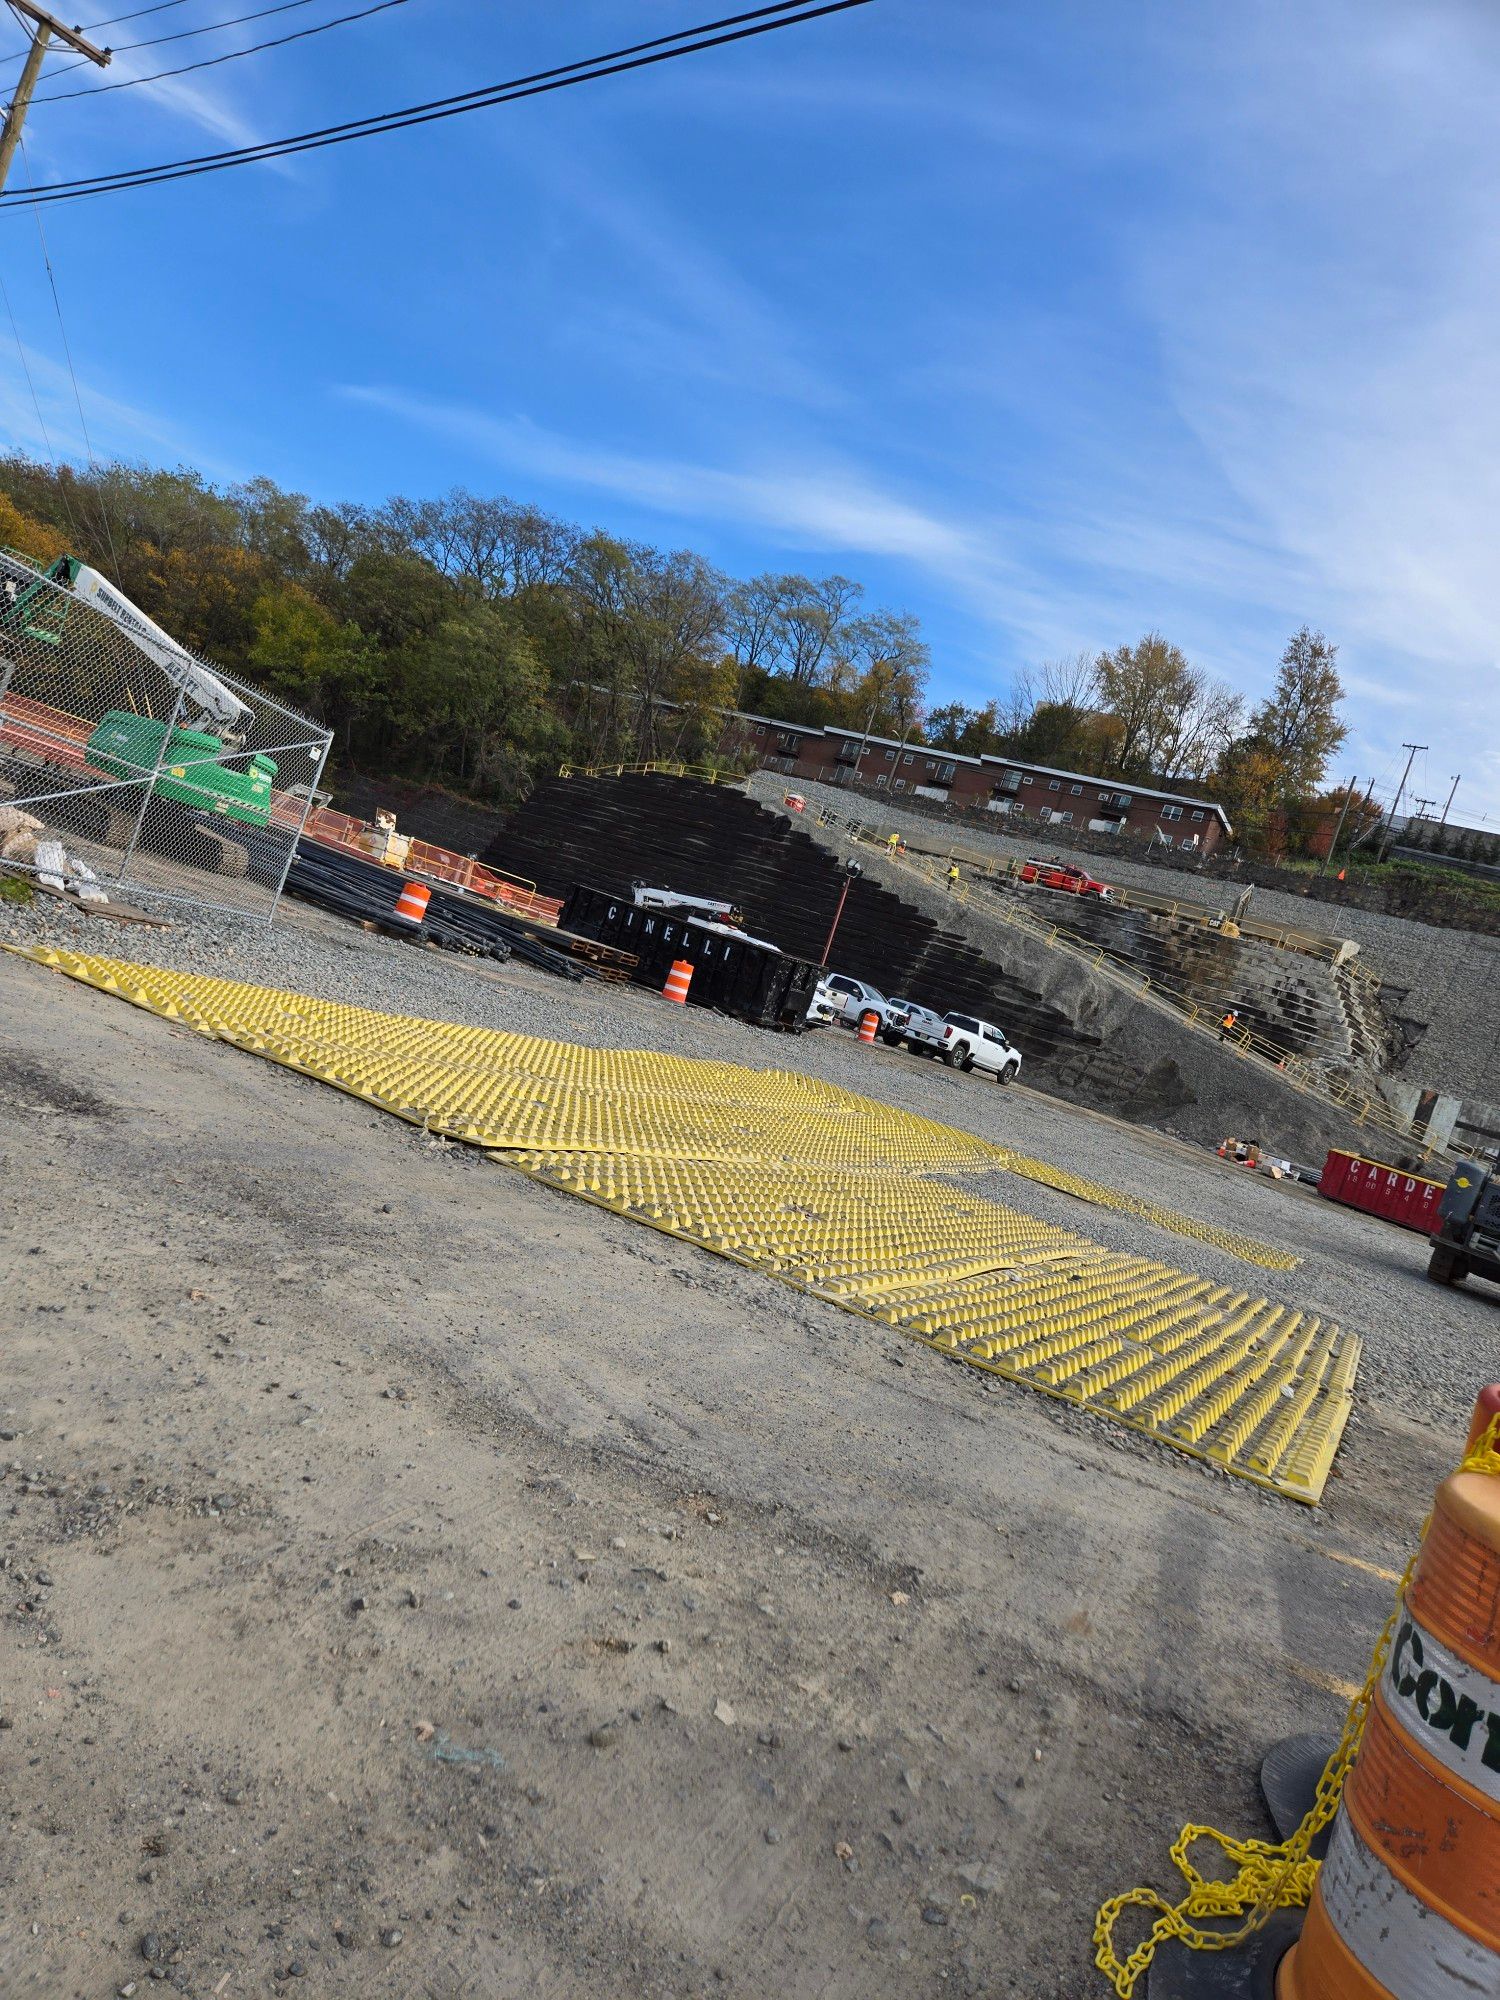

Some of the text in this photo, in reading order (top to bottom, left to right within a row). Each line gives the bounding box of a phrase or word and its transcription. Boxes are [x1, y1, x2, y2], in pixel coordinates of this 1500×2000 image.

[97, 587, 122, 615] SUNBELT
[608, 906, 731, 961] CINELLI
[1209, 919, 1221, 928] CAT
[1350, 1160, 1436, 1200] CARDE
